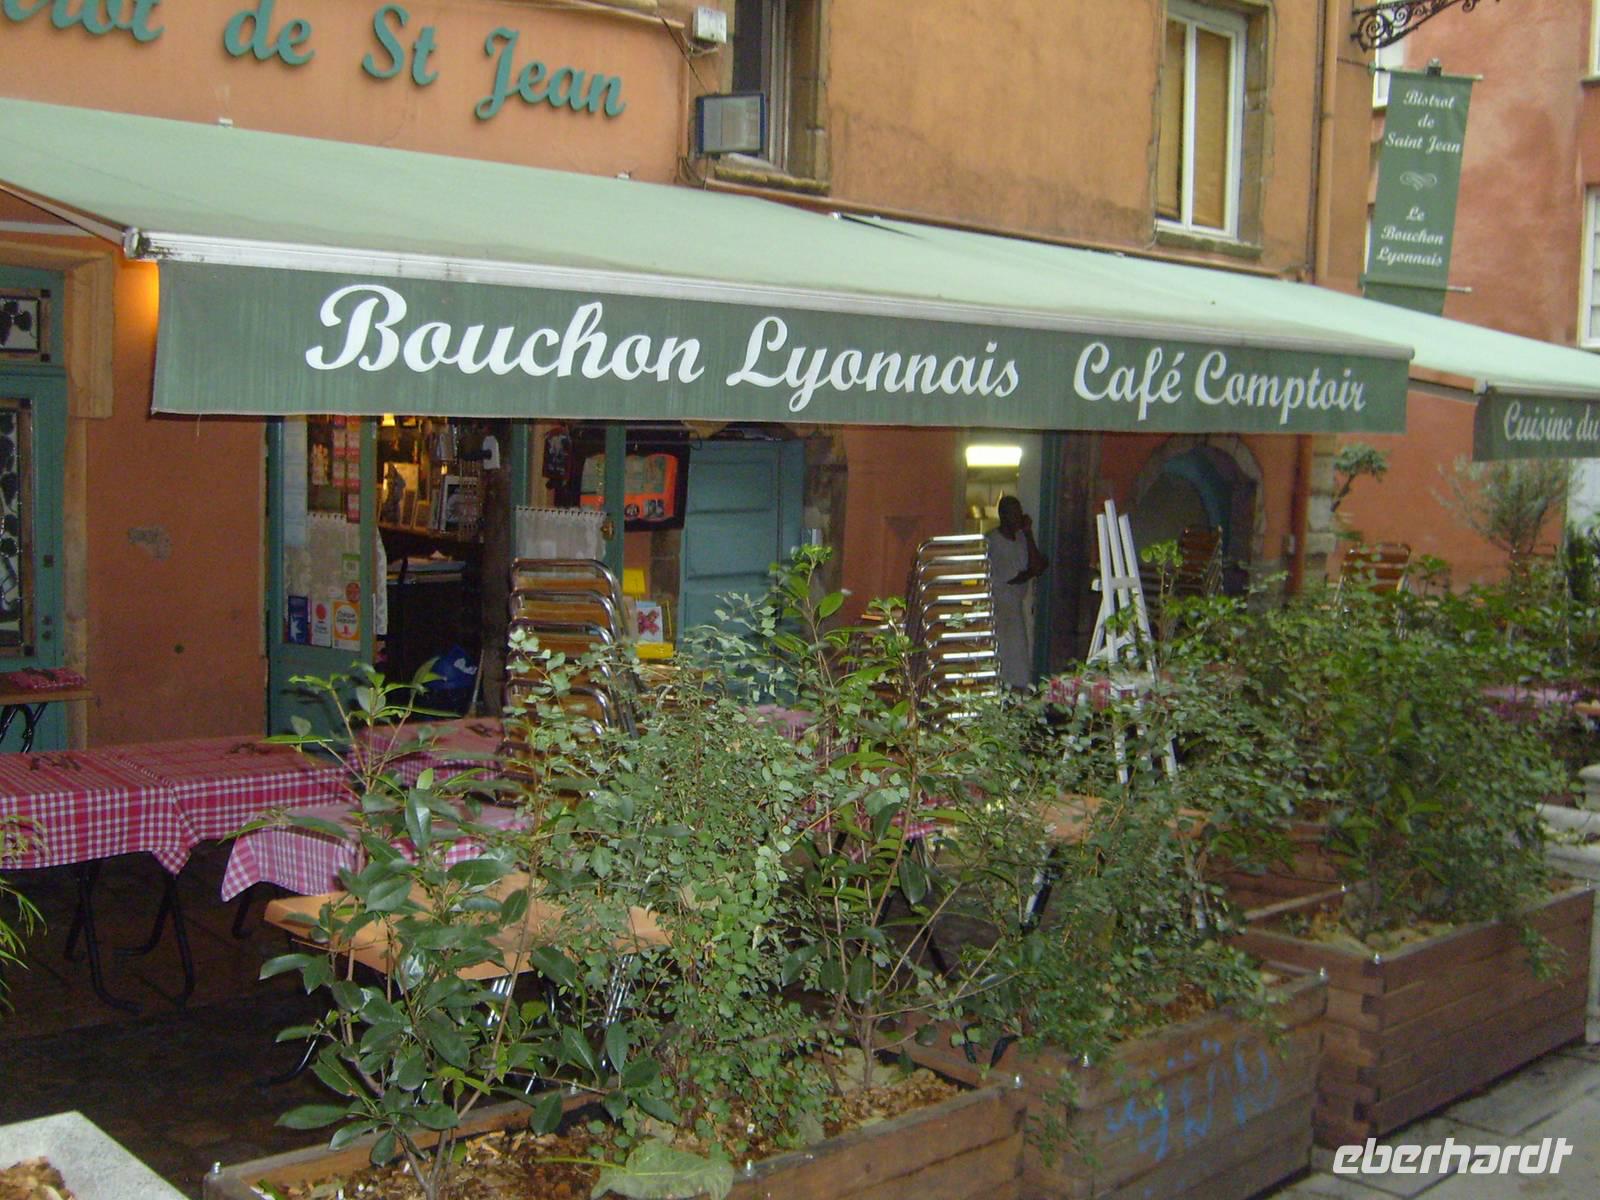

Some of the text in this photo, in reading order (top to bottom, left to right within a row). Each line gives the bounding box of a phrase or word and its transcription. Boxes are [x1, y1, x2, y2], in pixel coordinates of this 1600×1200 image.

[222, 0, 316, 66] de
[362, 4, 439, 87] St
[475, 26, 627, 120] Jean
[1402, 88, 1455, 110] Bistrot
[1417, 113, 1435, 129] de
[1384, 131, 1462, 155] Saint Jean
[1405, 206, 1425, 221] Le
[1380, 224, 1444, 246] Bouchon
[1376, 246, 1443, 267] Lyonnais
[305, 284, 1366, 425] Bouchon Lyonnais Café Comptoir
[1503, 400, 1572, 441] Cuisine
